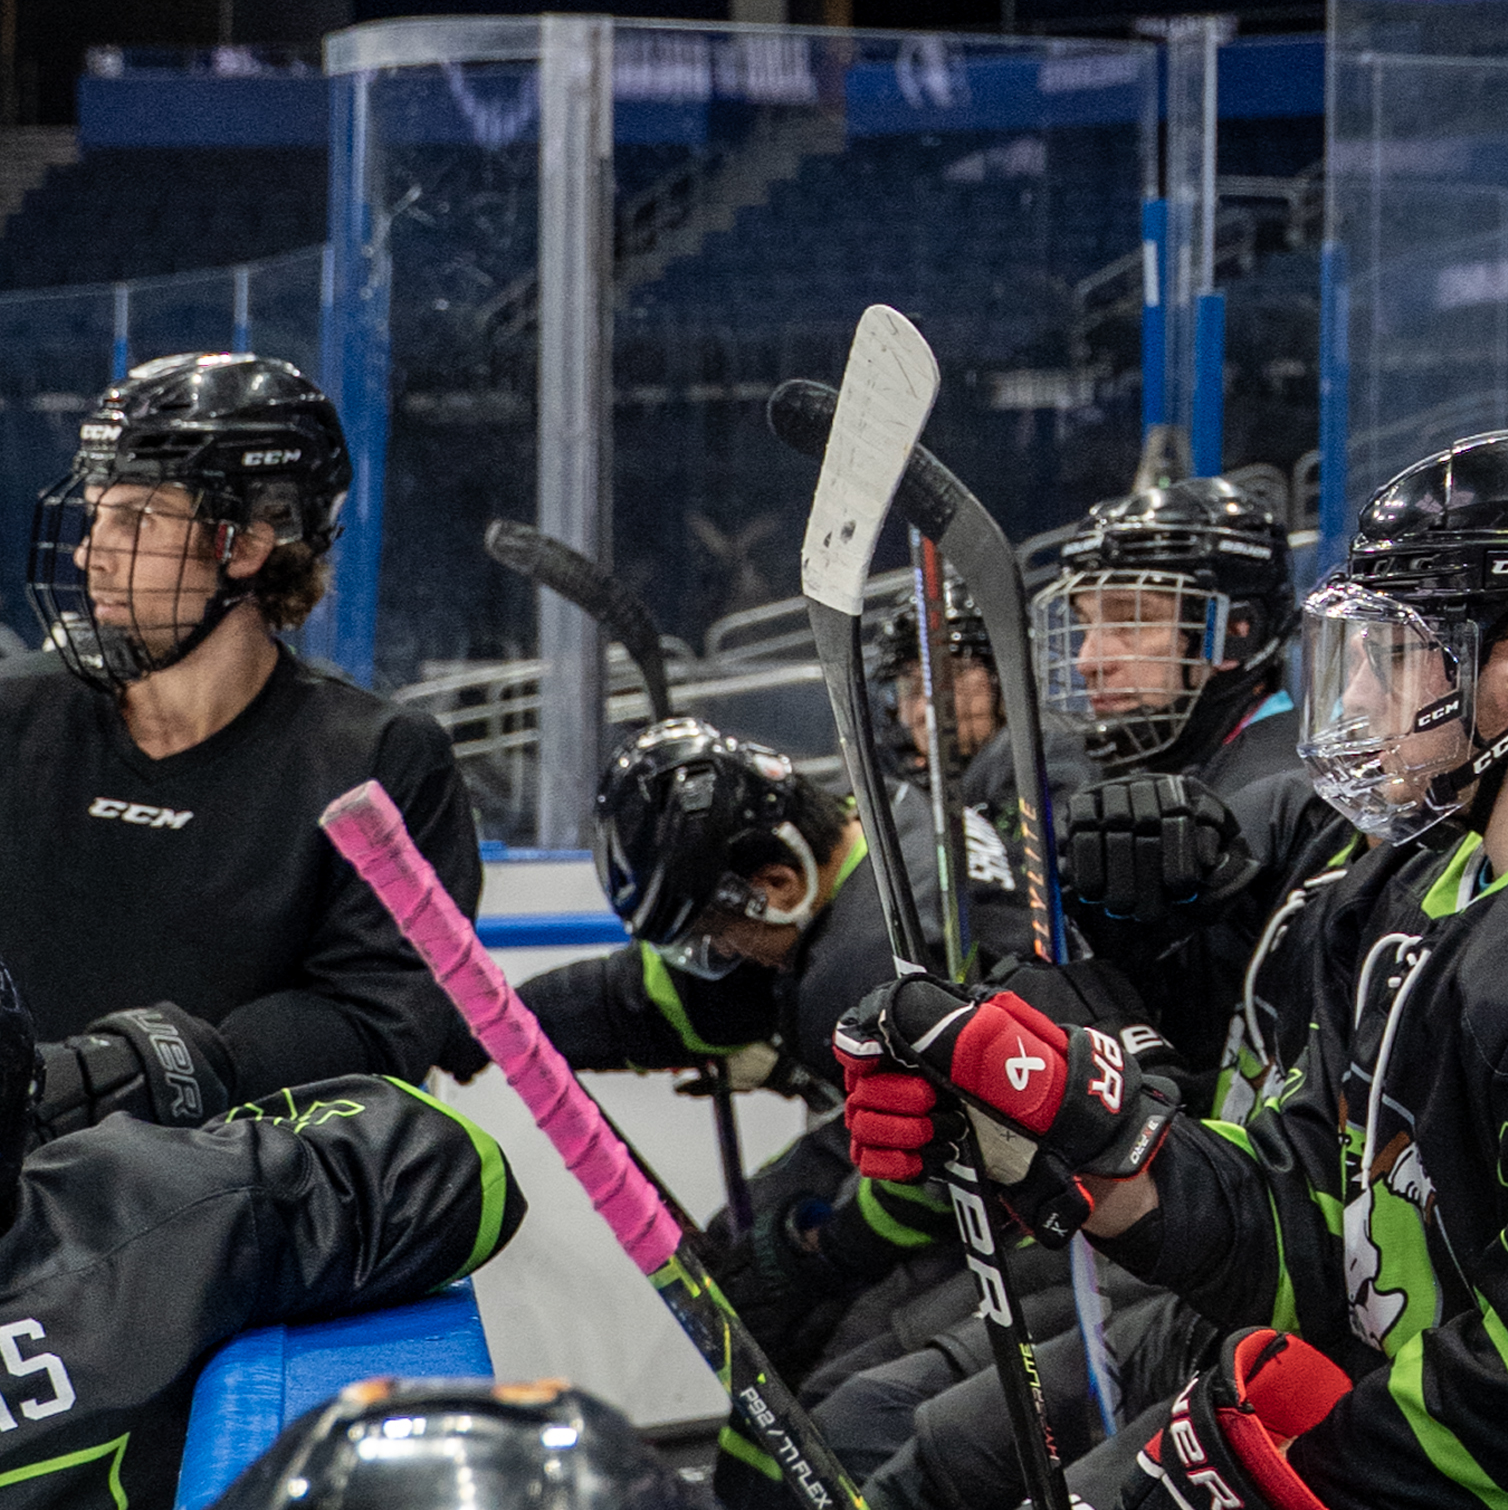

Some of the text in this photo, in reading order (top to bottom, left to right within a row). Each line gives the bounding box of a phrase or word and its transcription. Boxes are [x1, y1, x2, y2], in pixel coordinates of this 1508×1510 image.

[80, 422, 122, 442] CCM
[241, 448, 303, 468] CCM
[1417, 699, 1460, 728] CCM
[88, 797, 194, 832] CCM
[1017, 798, 1053, 964] FLYLITE
[739, 1386, 776, 1430] P92
[779, 1435, 800, 1463] 77
